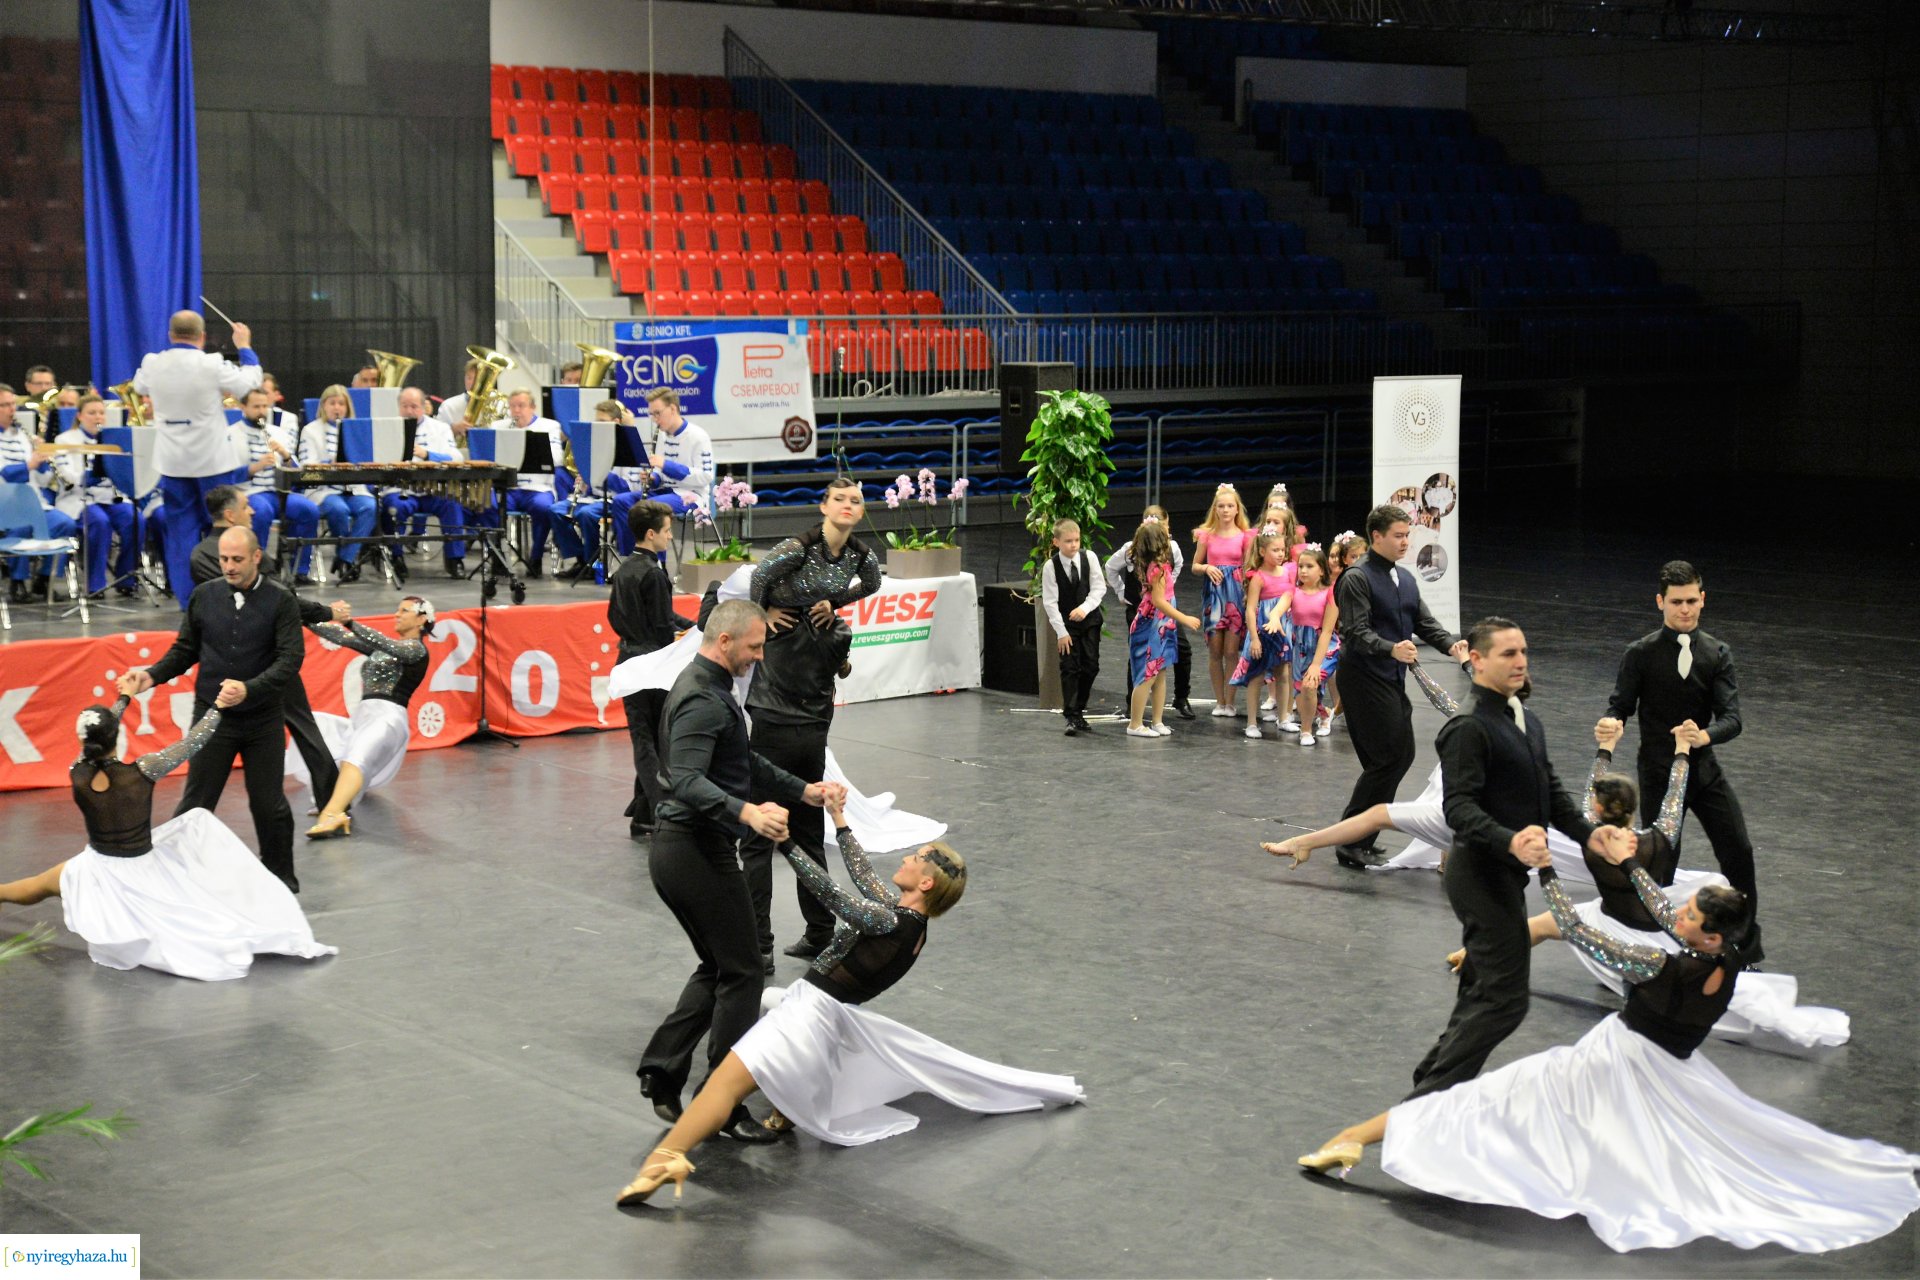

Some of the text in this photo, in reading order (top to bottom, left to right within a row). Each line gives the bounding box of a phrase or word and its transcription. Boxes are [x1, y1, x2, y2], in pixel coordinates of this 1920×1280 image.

[645, 324, 692, 337] SENIO KFT.
[743, 344, 784, 379] Pietra
[621, 353, 699, 386] SENIO
[730, 382, 800, 398] CSEMPEBOLT
[742, 401, 790, 410] www.pietra.hu
[852, 629, 929, 644] .reveszgroup.com
